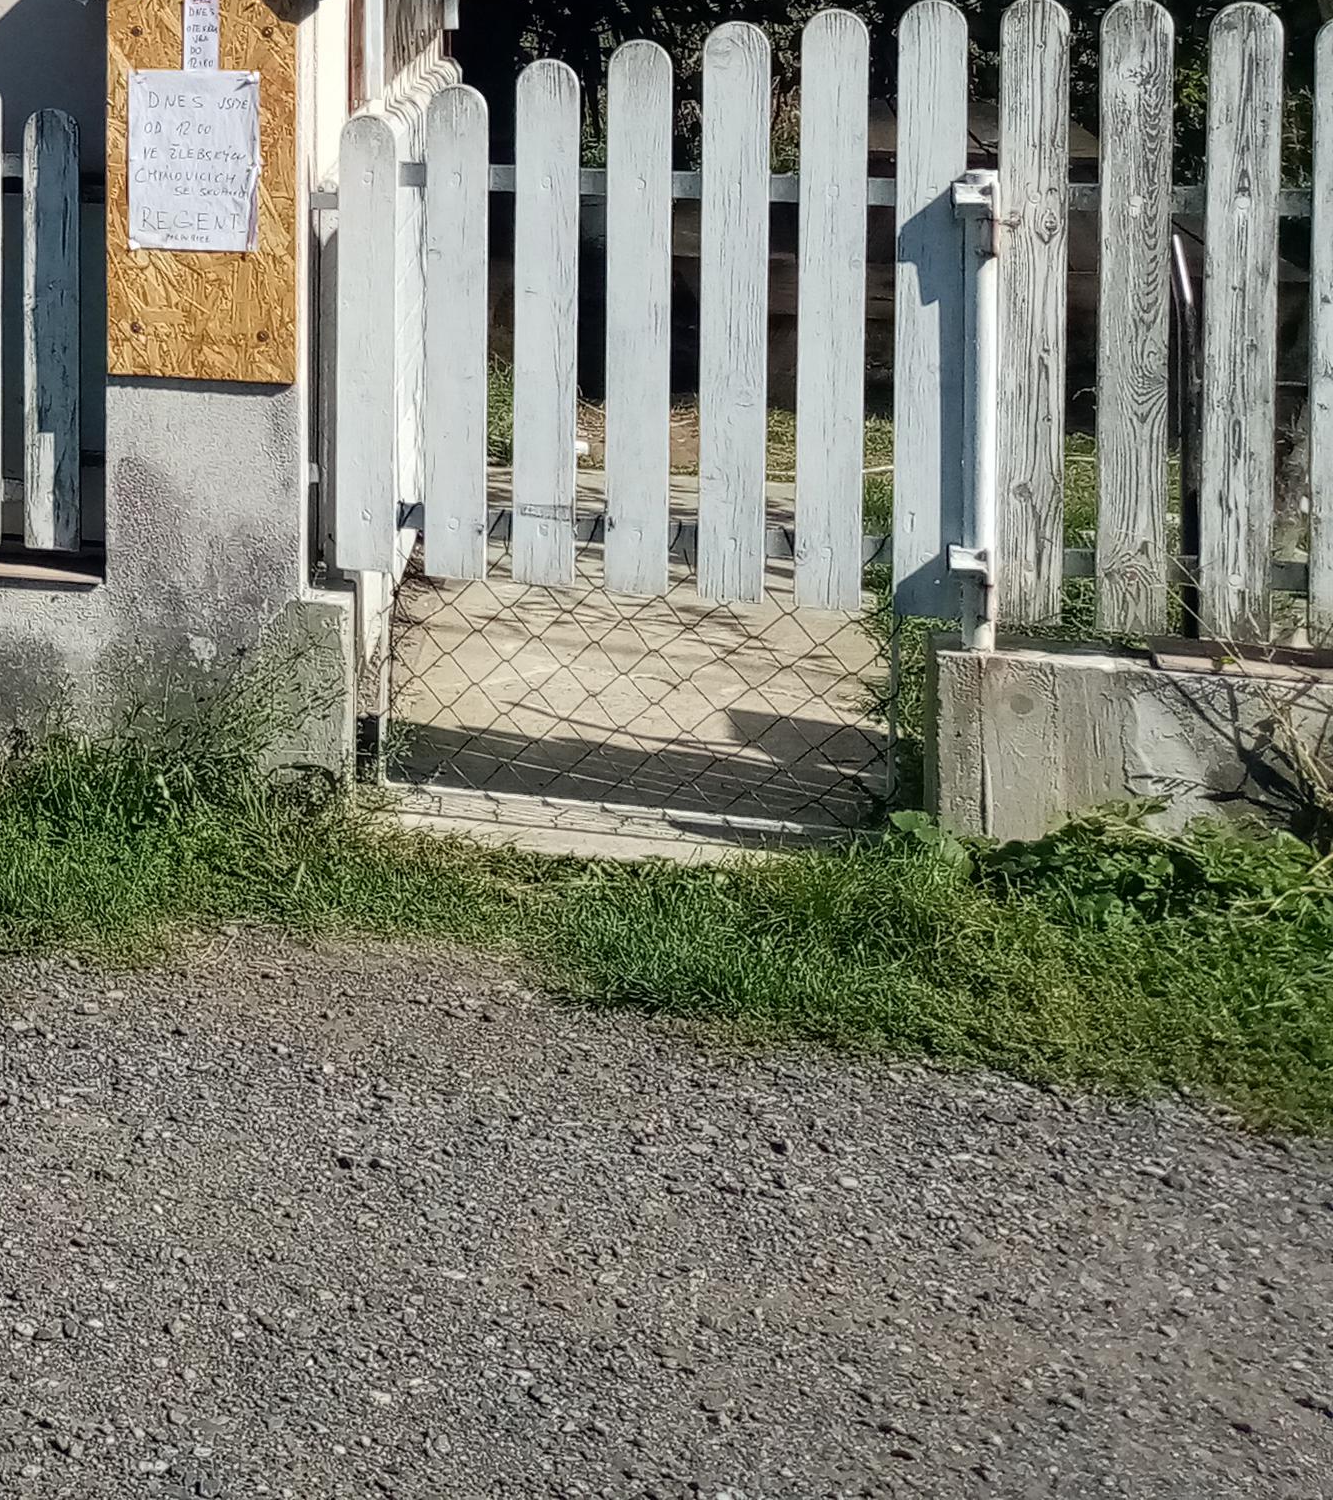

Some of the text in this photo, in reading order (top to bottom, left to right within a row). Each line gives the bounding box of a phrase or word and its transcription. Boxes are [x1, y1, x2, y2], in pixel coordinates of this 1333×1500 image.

[148, 91, 204, 109] DNES
[143, 121, 162, 135] OD
[143, 147, 158, 159] VE
[139, 206, 242, 232] REGENT
